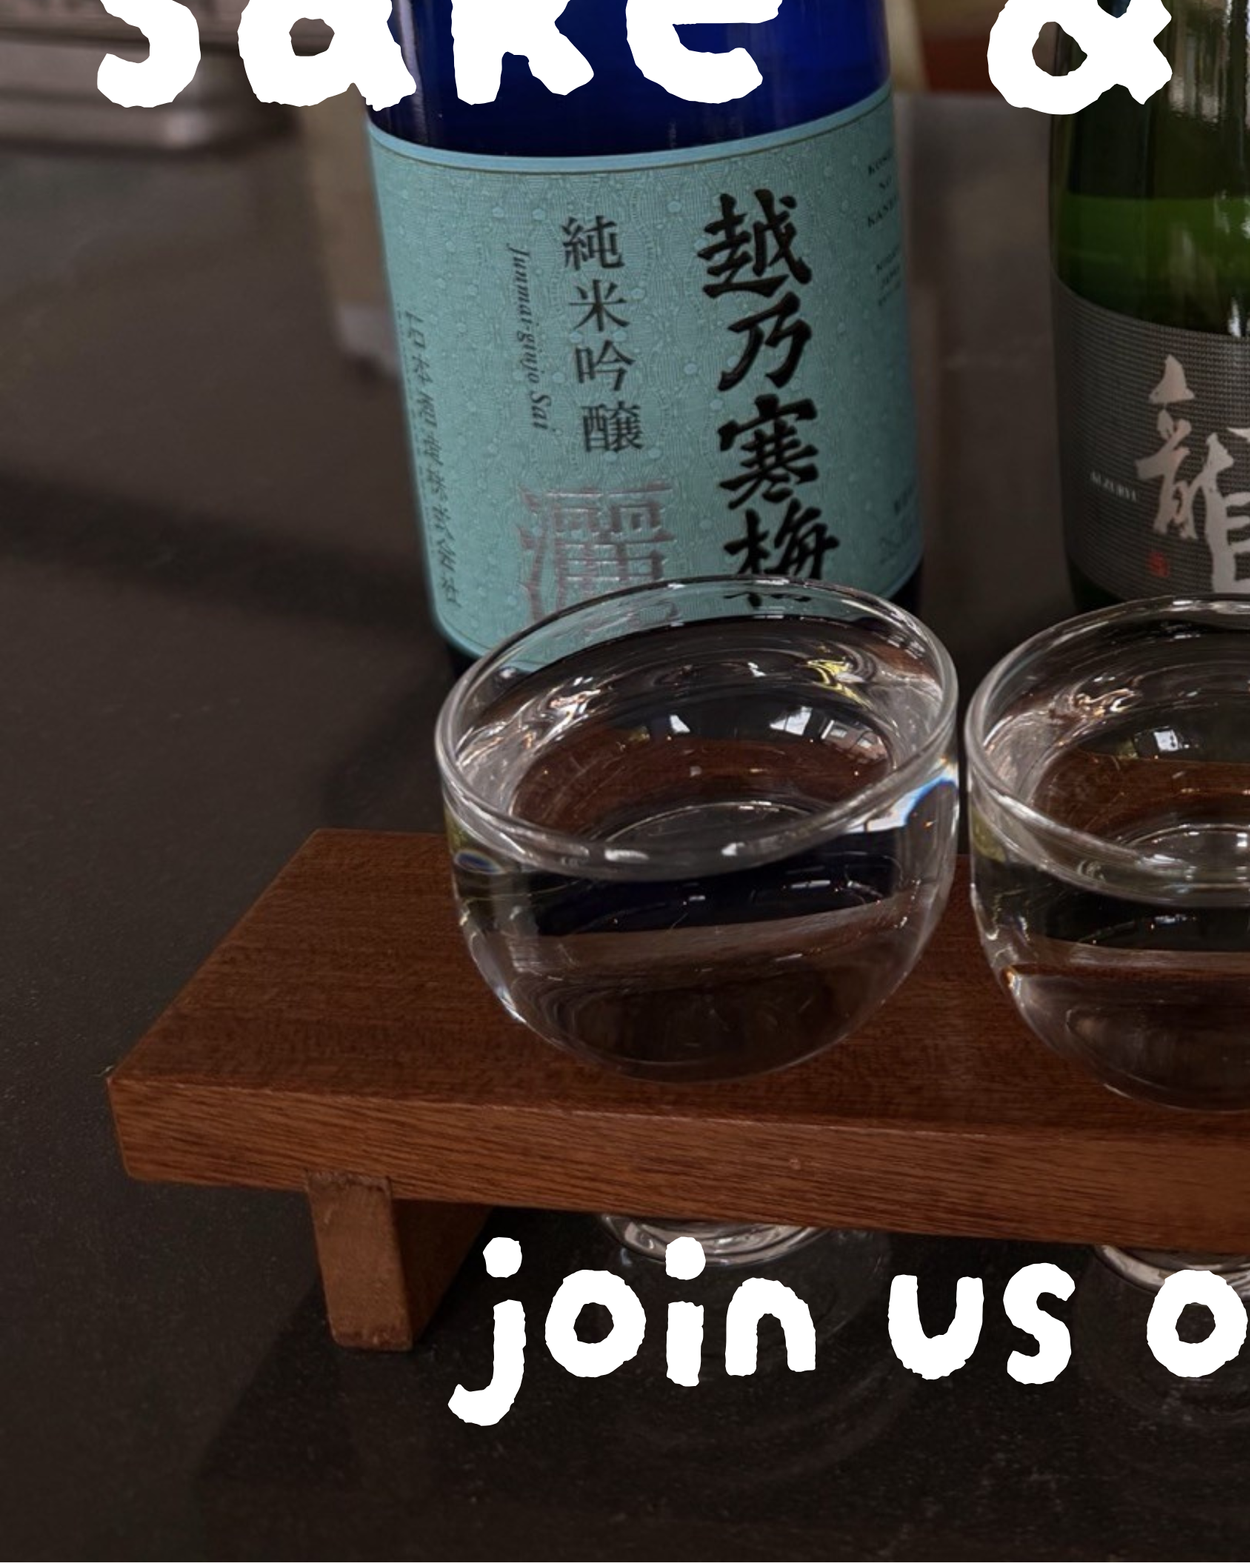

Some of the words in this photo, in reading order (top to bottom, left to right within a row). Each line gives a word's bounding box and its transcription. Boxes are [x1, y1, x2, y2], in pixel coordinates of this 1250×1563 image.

[530, 392, 553, 431] Sai
[561, 214, 645, 454] 純米吟醸
[698, 188, 839, 604] 越乃寒梅
